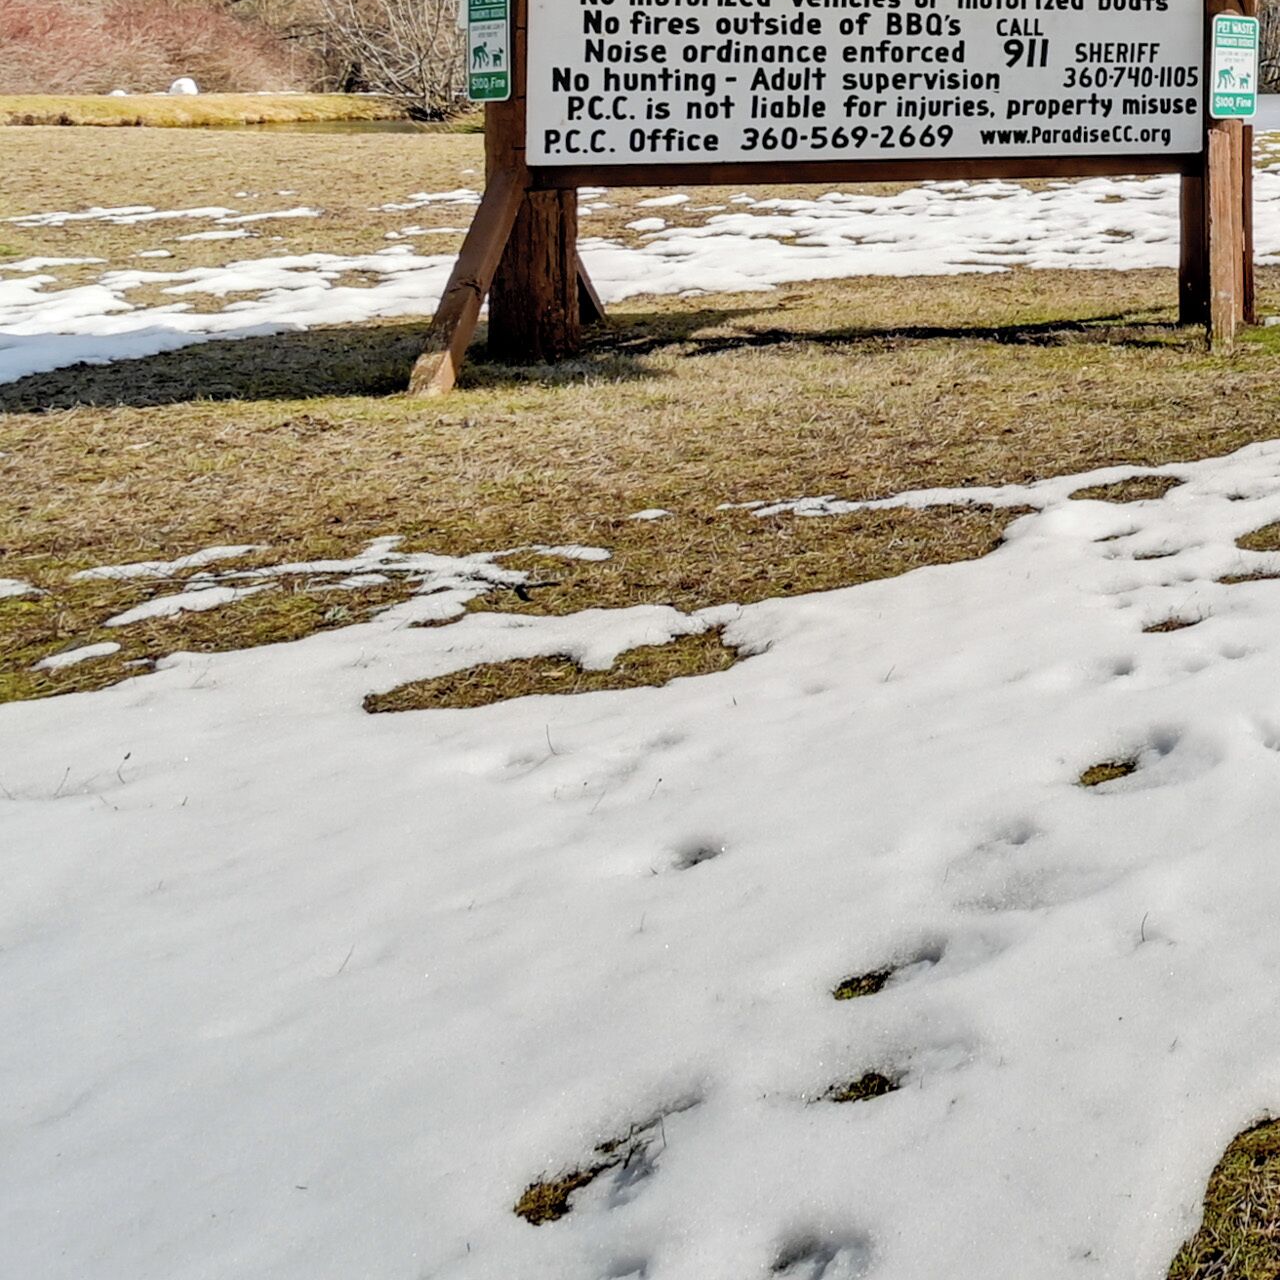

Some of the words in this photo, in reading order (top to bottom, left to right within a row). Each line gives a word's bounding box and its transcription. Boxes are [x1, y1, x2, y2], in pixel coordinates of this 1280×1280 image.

[583, 9, 620, 35] No
[629, 10, 700, 35] fires
[715, 11, 822, 36] outside
[839, 12, 872, 36] of
[886, 12, 962, 37] BBQ's
[996, 18, 1044, 37] CALL
[1216, 21, 1231, 33] PET
[1232, 21, 1255, 35] WASTE
[584, 38, 667, 64] Noise
[682, 39, 827, 64] ordinance
[842, 39, 965, 64] enforced
[1003, 38, 1049, 68] 911
[1075, 42, 1161, 64] SHERIFF
[552, 67, 590, 93] No
[603, 67, 716, 97] hunting
[749, 66, 827, 92] Adult
[842, 68, 1000, 94] supervision
[1062, 65, 1199, 89] 360-740-1105
[567, 95, 636, 121] P.C.C.
[646, 97, 671, 120] is
[686, 94, 736, 120] not
[751, 94, 826, 119] liable
[842, 94, 888, 118] for
[896, 95, 995, 121] injuries,
[1006, 92, 1113, 120] property
[1122, 94, 1198, 116] misuse
[544, 129, 616, 154] P.C.C.
[629, 127, 719, 153] Office
[740, 124, 954, 151] 360-569-2669
[979, 125, 1171, 147] www.ParadiseCC.org
